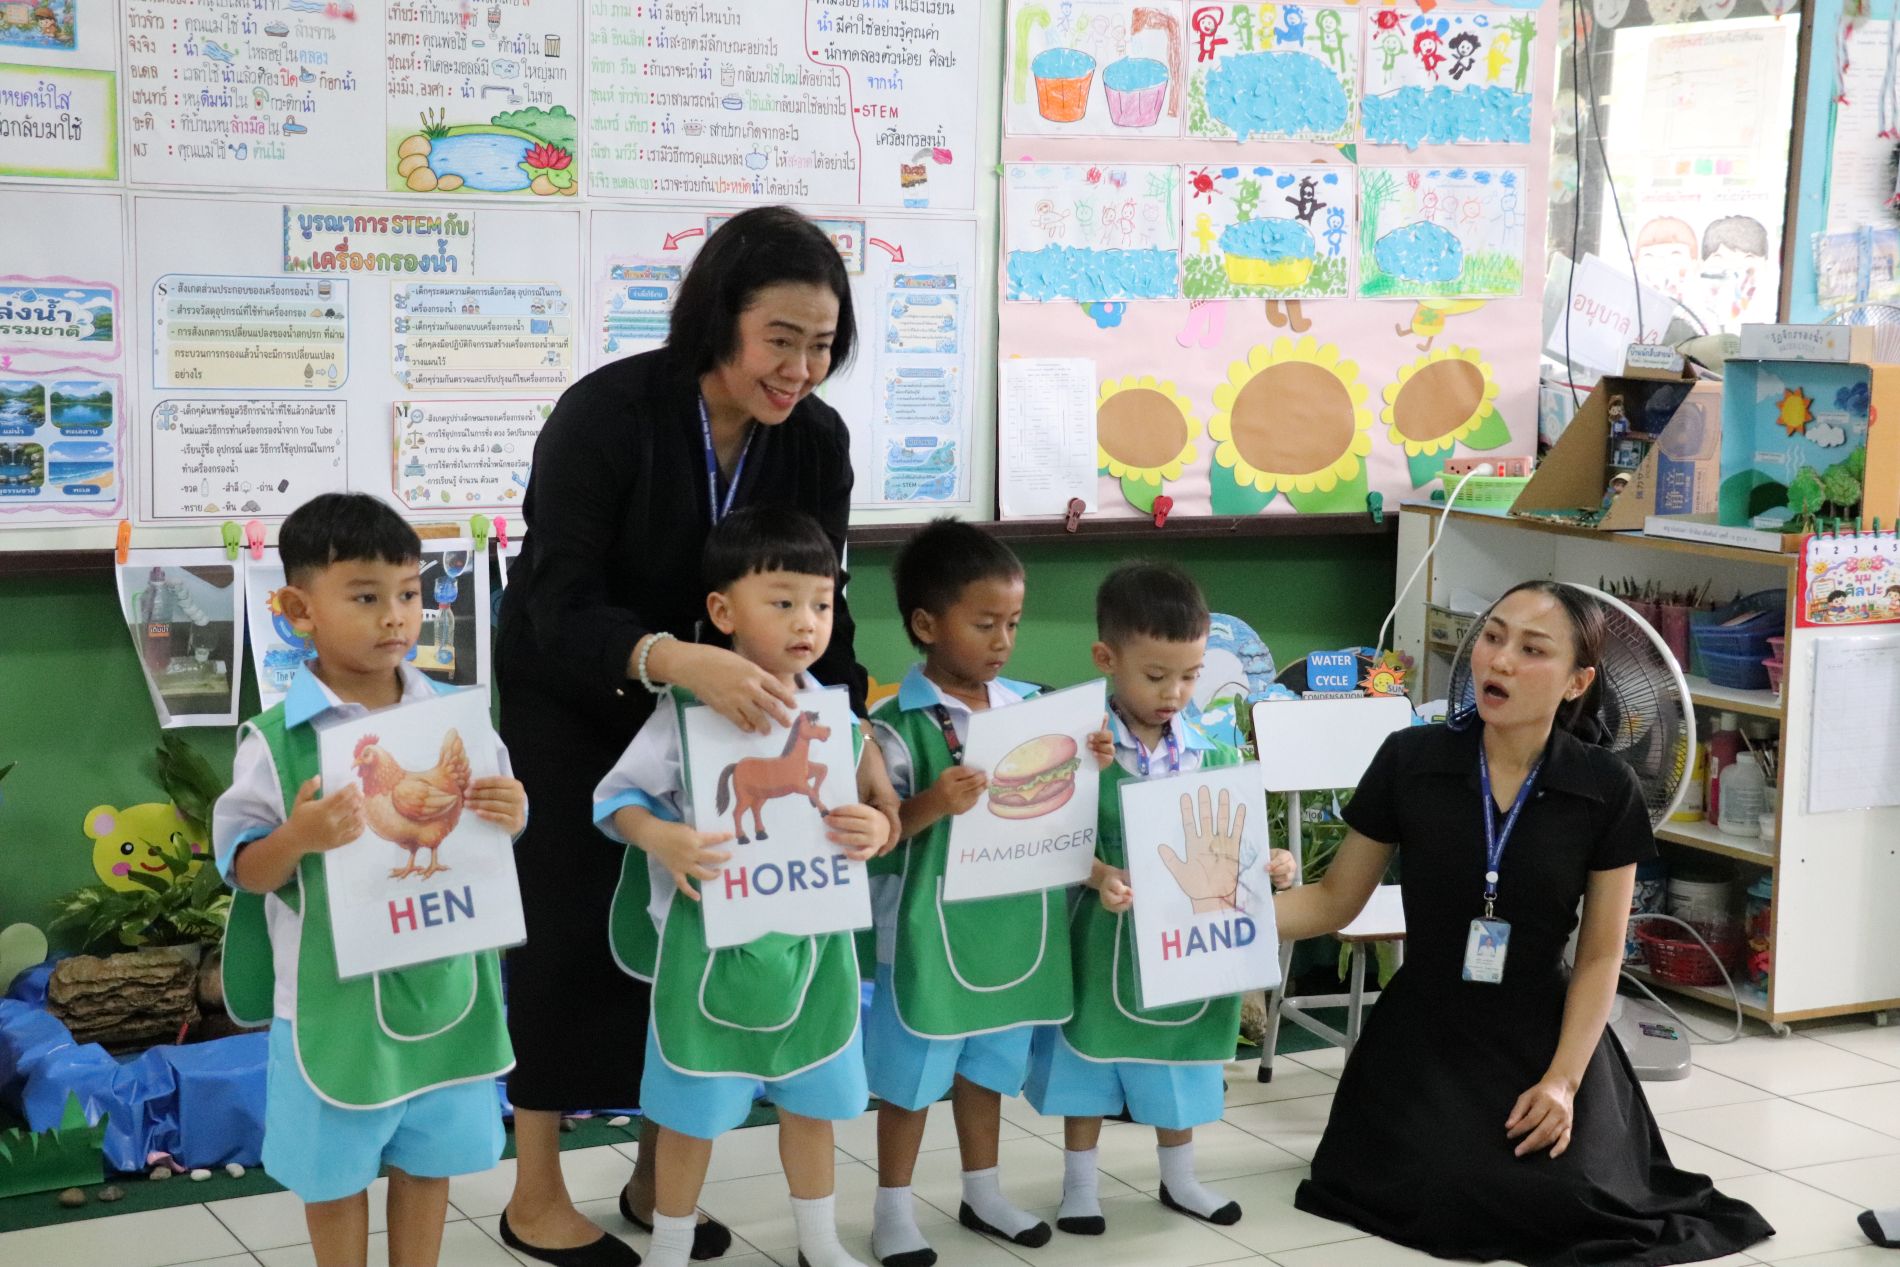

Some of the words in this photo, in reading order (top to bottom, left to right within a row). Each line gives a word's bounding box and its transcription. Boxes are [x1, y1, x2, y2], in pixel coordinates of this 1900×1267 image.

[862, 104, 899, 118] STEM
[298, 213, 389, 240] บูรณาการ
[391, 214, 442, 235] STEM
[444, 212, 470, 236] กับ
[312, 236, 459, 273] เครื่องกรองน้ำ
[1311, 655, 1352, 666] WATER
[1315, 675, 1349, 686] CYCLE
[1388, 684, 1405, 693] SUN
[960, 828, 1094, 864] HAMBURGER
[724, 854, 850, 900] HORSE
[388, 885, 475, 934] HEN
[1161, 917, 1256, 961] HAND
